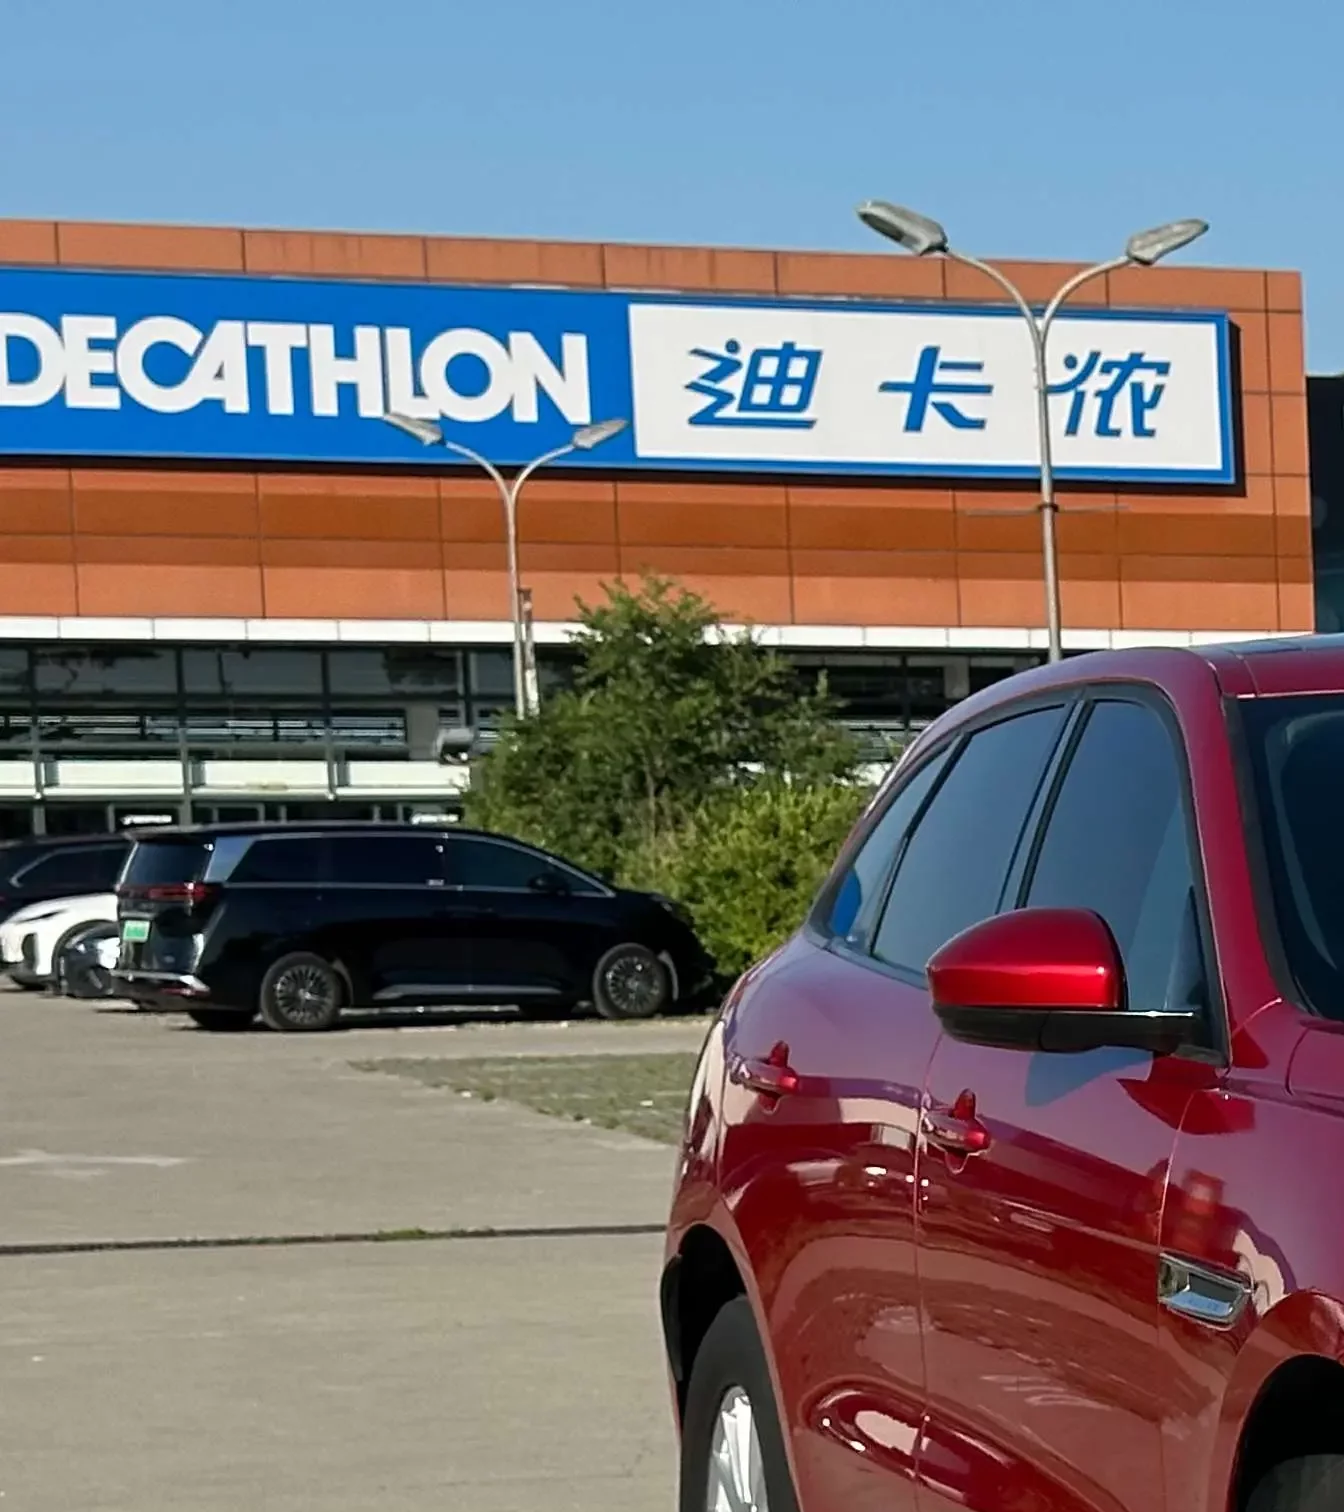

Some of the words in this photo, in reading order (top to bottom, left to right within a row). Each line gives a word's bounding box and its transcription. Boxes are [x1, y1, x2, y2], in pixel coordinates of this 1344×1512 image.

[0, 312, 592, 425] DECATHLON
[685, 338, 1171, 438] 迪卡侬
